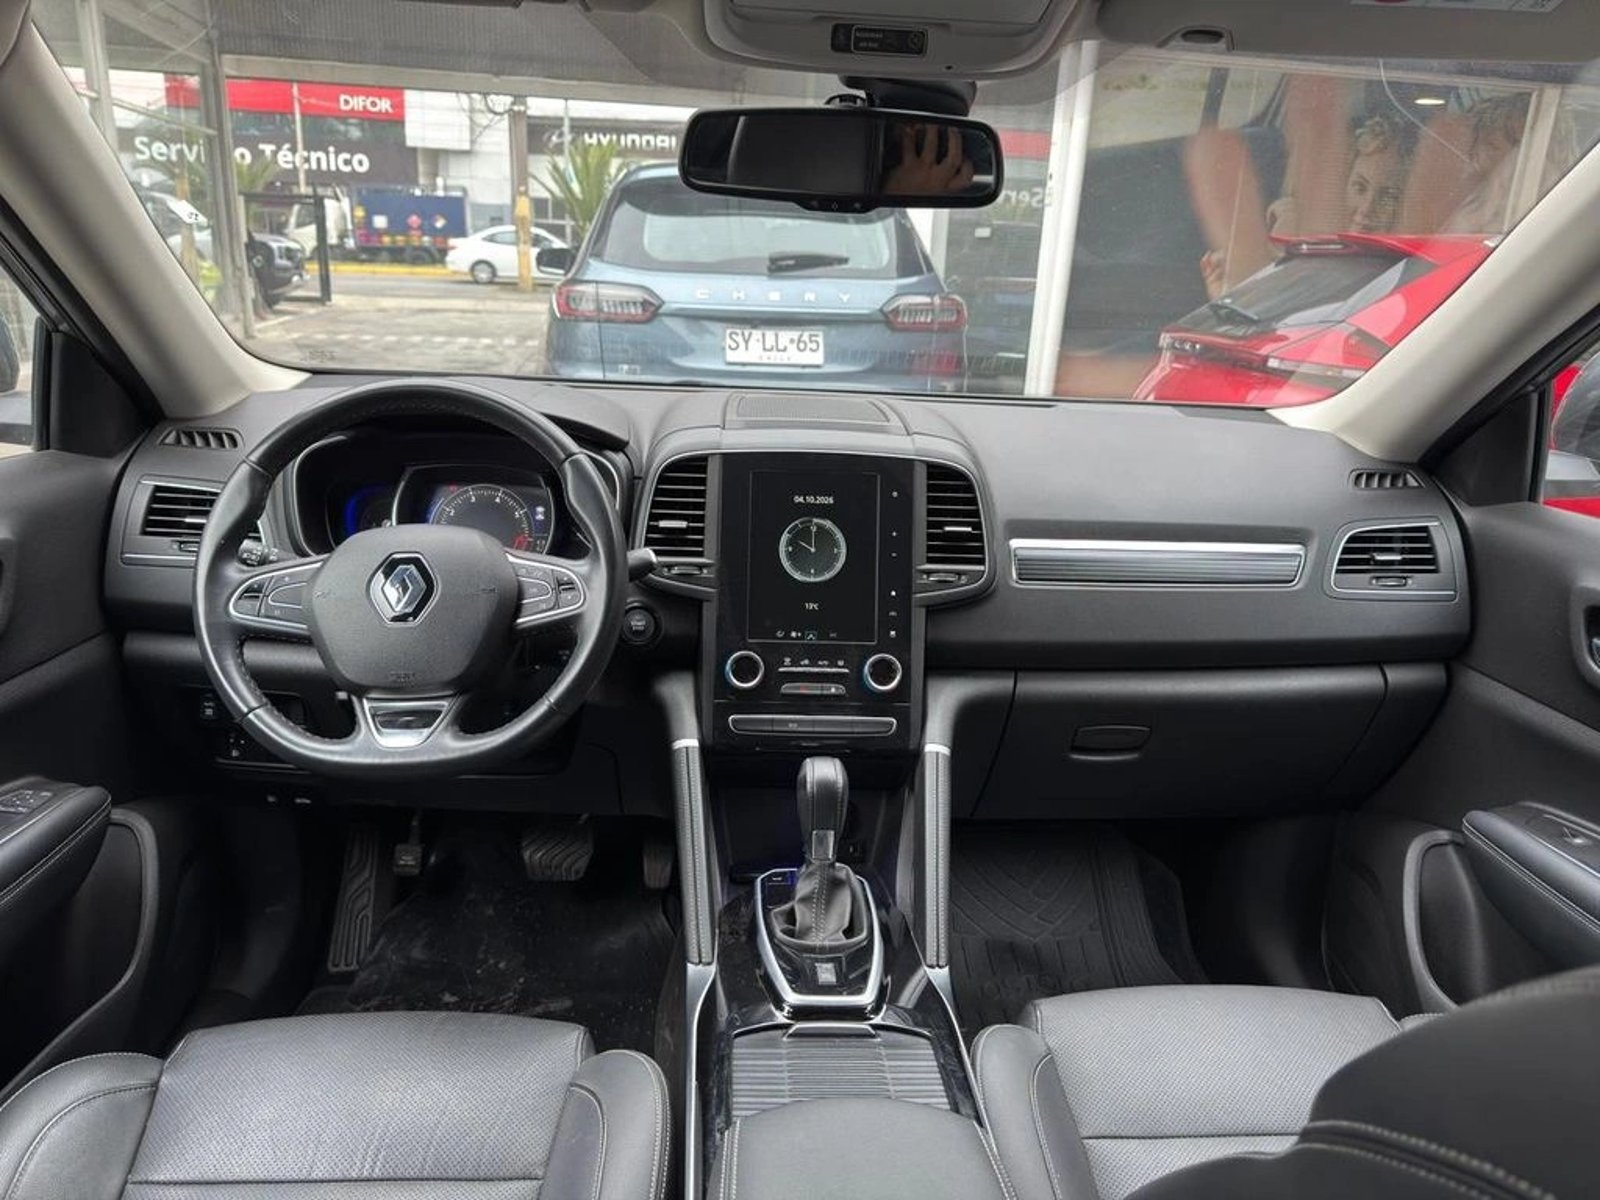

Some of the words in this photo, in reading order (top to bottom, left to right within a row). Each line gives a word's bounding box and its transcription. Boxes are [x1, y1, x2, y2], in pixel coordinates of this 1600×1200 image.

[339, 94, 393, 113] DIFOR
[134, 137, 252, 164] Servio
[258, 142, 370, 172] Técnico
[696, 288, 851, 303] CHERY
